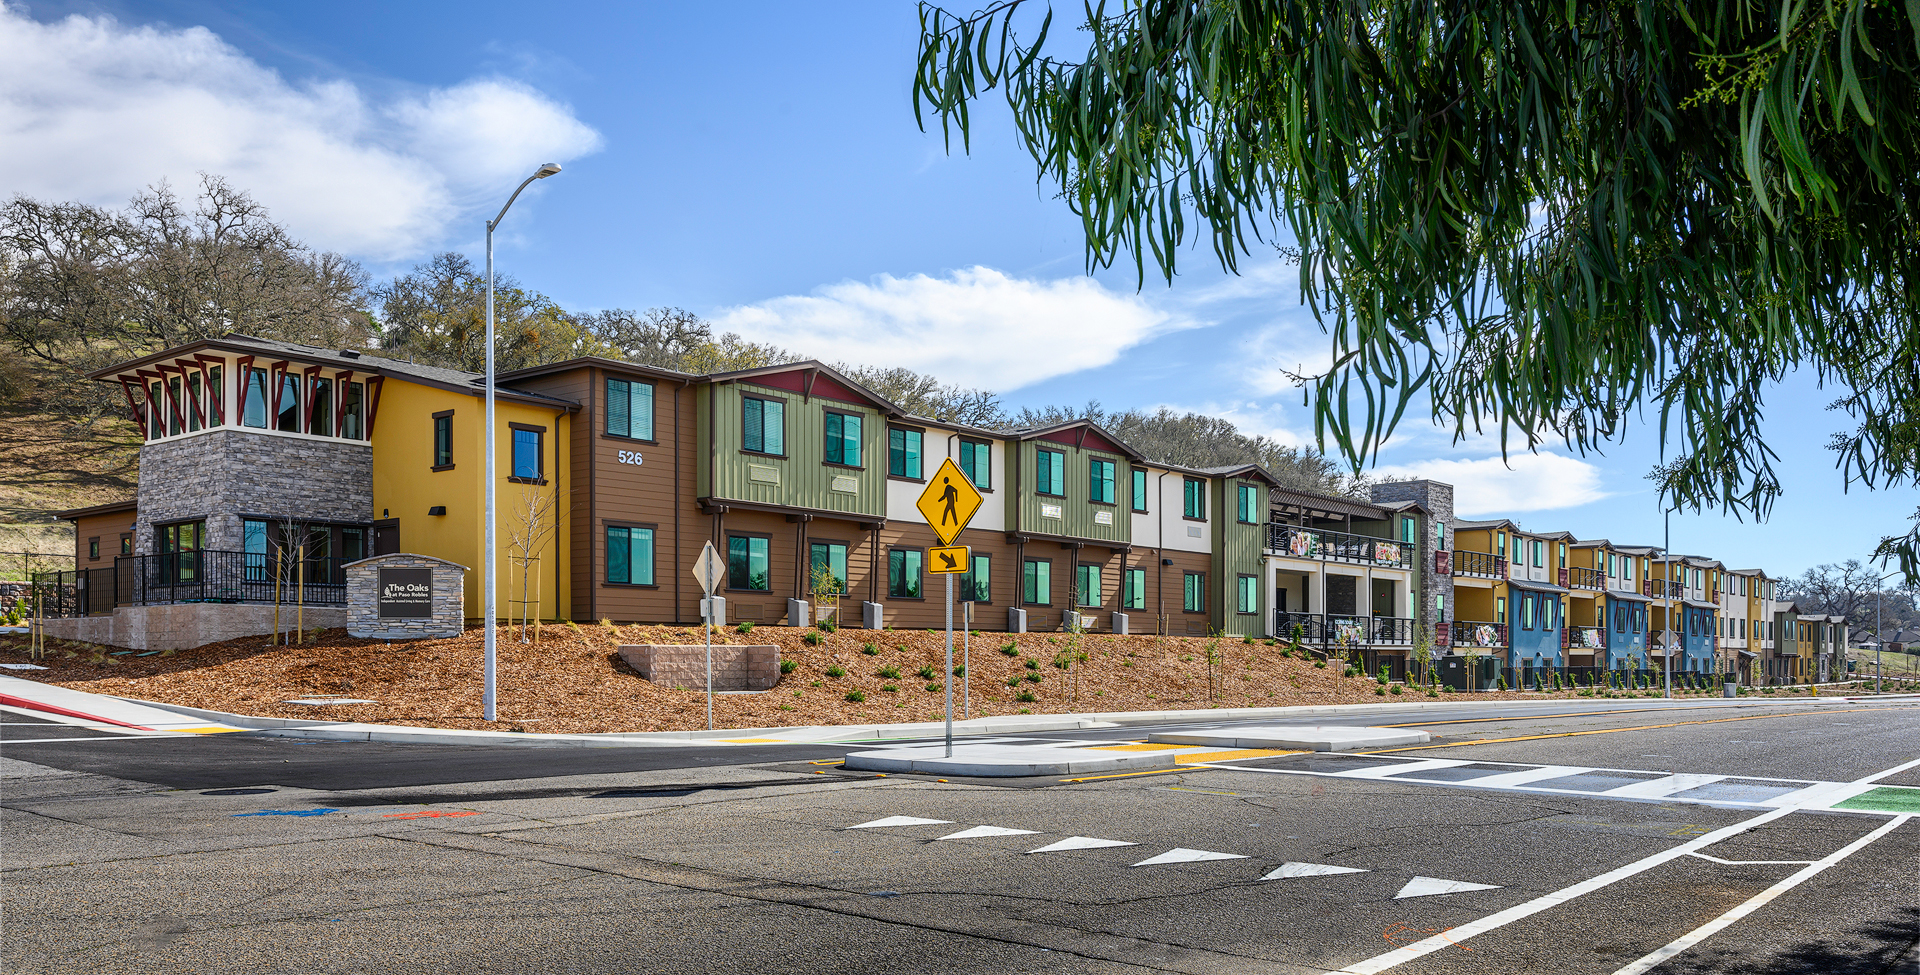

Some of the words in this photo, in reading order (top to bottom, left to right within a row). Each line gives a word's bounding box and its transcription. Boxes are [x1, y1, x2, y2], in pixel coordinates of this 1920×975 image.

[618, 450, 643, 466] 526
[389, 583, 405, 591] The
[406, 583, 429, 591] Oaks
